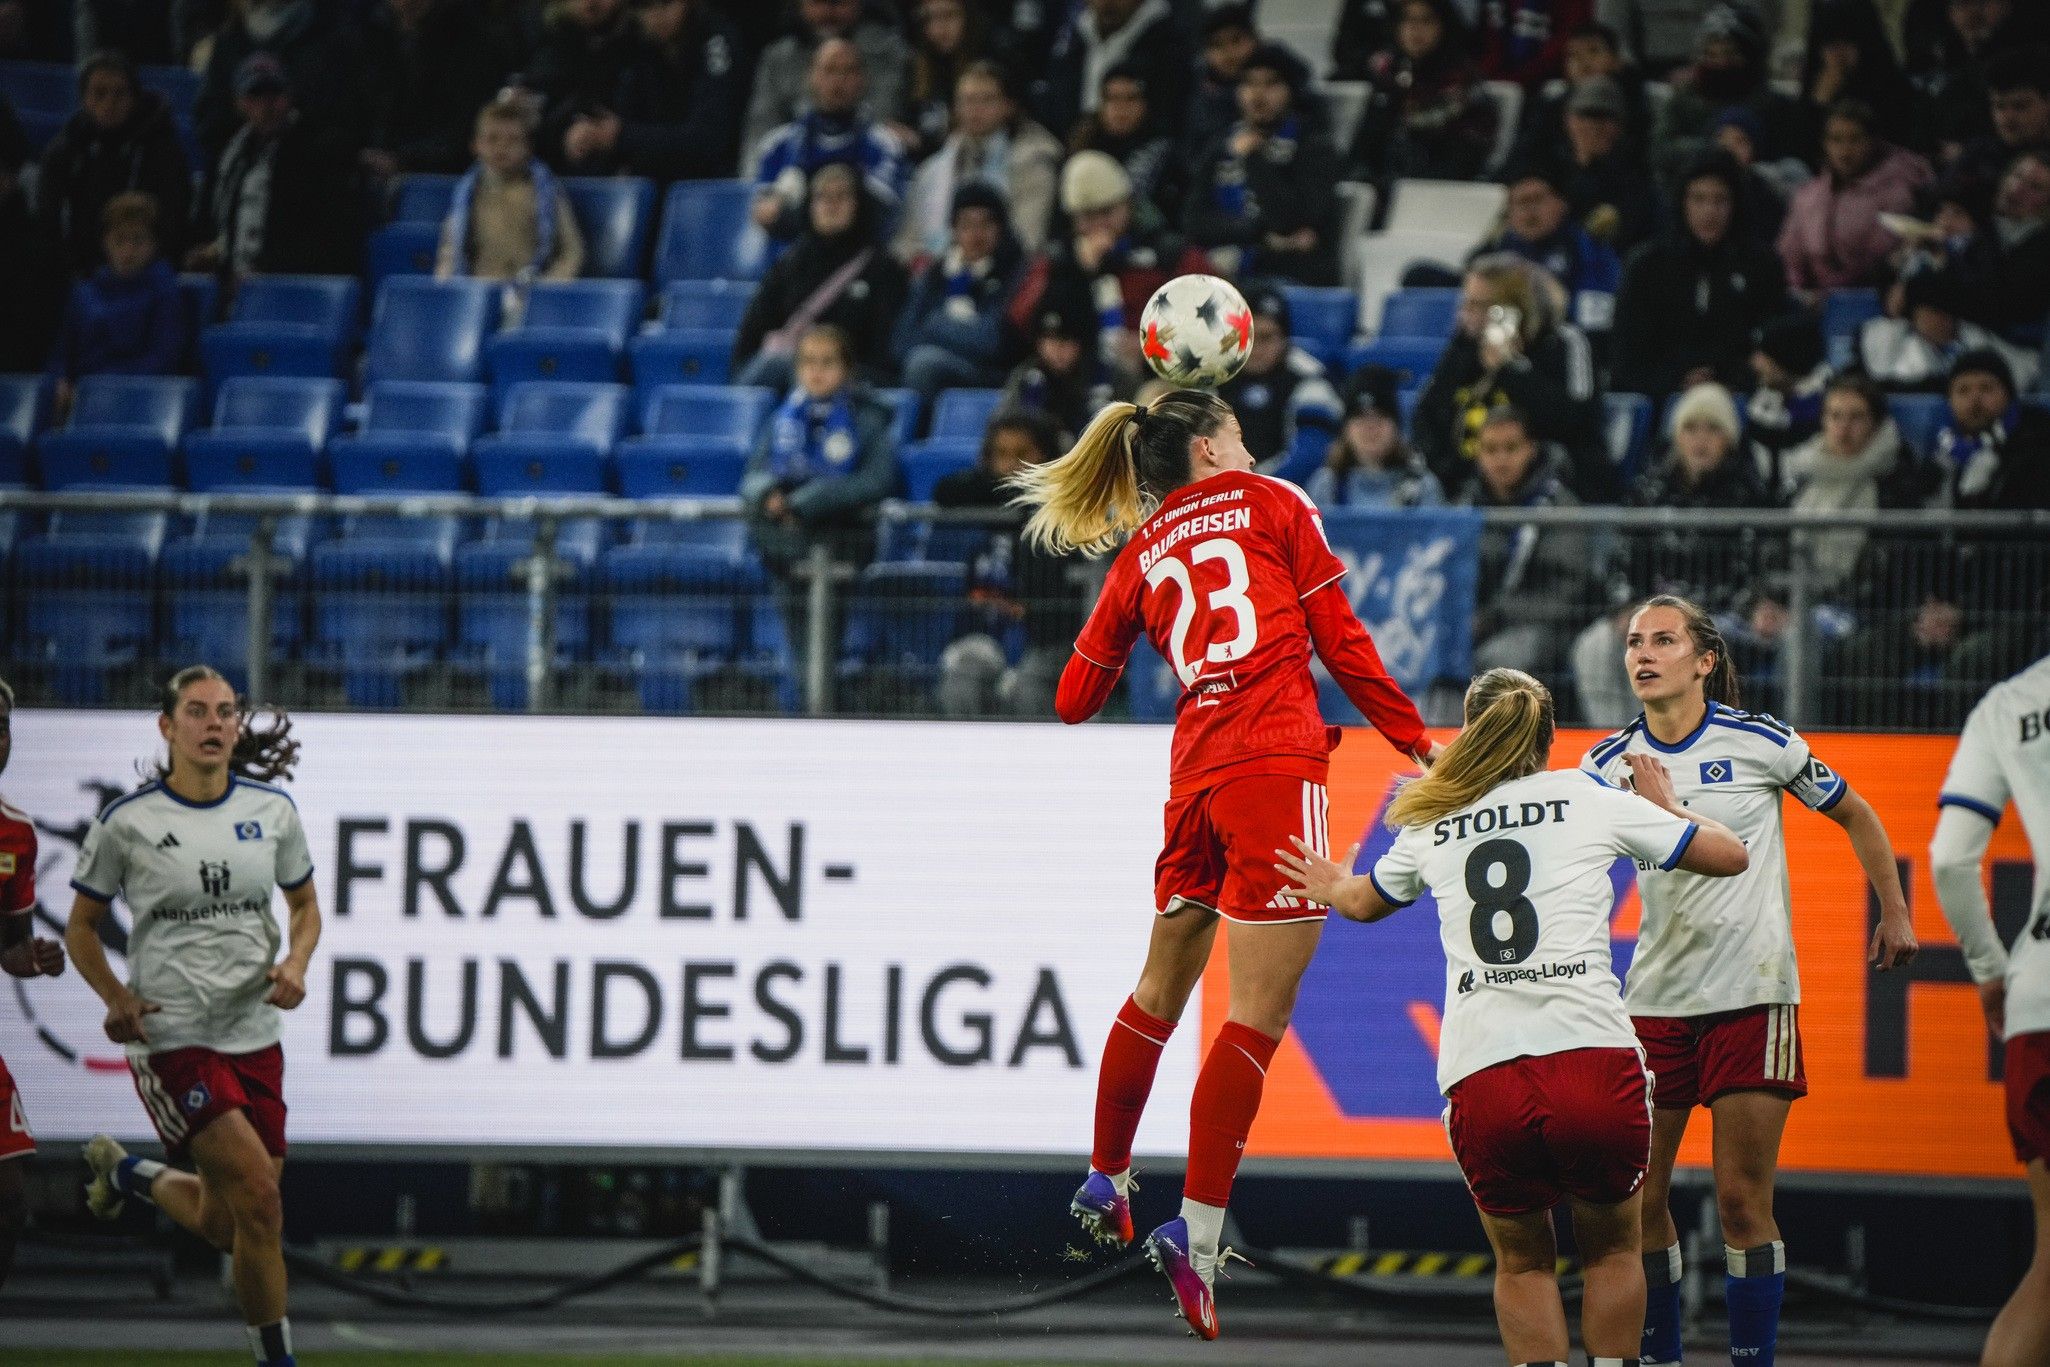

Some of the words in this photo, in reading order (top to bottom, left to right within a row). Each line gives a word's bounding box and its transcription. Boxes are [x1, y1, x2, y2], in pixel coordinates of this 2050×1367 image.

[1138, 507, 1251, 575] BAUEREISEN
[1142, 527, 1152, 540] 1.
[1152, 516, 1165, 533] FC
[1164, 500, 1200, 522] UNION
[1200, 489, 1245, 508] BERLIN
[1144, 537, 1258, 690] 23
[1433, 799, 1570, 847] STOLDT
[332, 816, 856, 923] FRAUEN-
[1464, 838, 1540, 966] 8
[327, 955, 1084, 1069] BUNDESLIGA
[1483, 960, 1587, 985] Hapag-Lloyd
